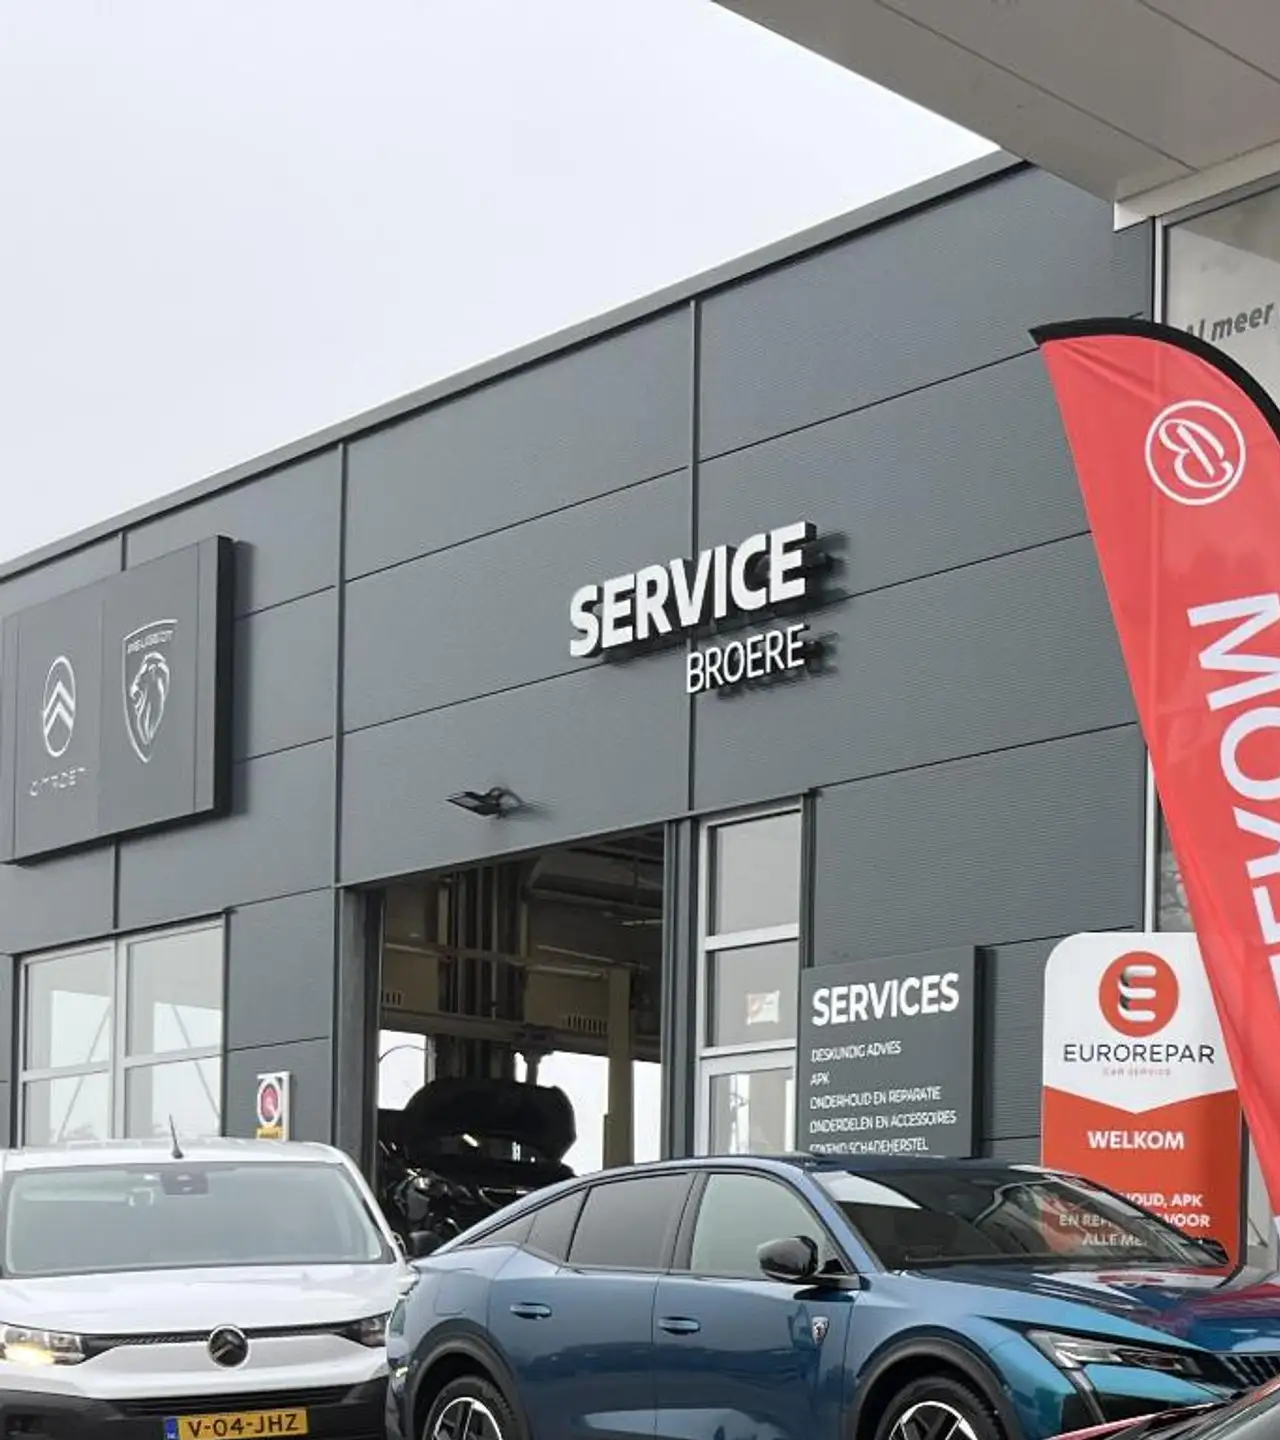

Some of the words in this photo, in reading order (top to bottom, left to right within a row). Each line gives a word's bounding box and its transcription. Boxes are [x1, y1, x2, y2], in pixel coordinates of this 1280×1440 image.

[1211, 302, 1274, 342] meer
[570, 521, 807, 659] SERVICE
[686, 624, 805, 694] BROERE
[812, 972, 960, 1026] SERVICES
[867, 1040, 902, 1057] ADVIES
[1063, 1043, 1215, 1065] EUROREPAR
[873, 1090, 887, 1106] EN
[889, 1085, 942, 1103] REPARATIE
[875, 1113, 889, 1130] EN
[1087, 1130, 1185, 1150] WELKOM
[1171, 1193, 1205, 1207] APK
[1059, 1214, 1080, 1227] EN
[1082, 1233, 1117, 1246] ALLE
[188, 1413, 300, 1439] V-04-JHZ
